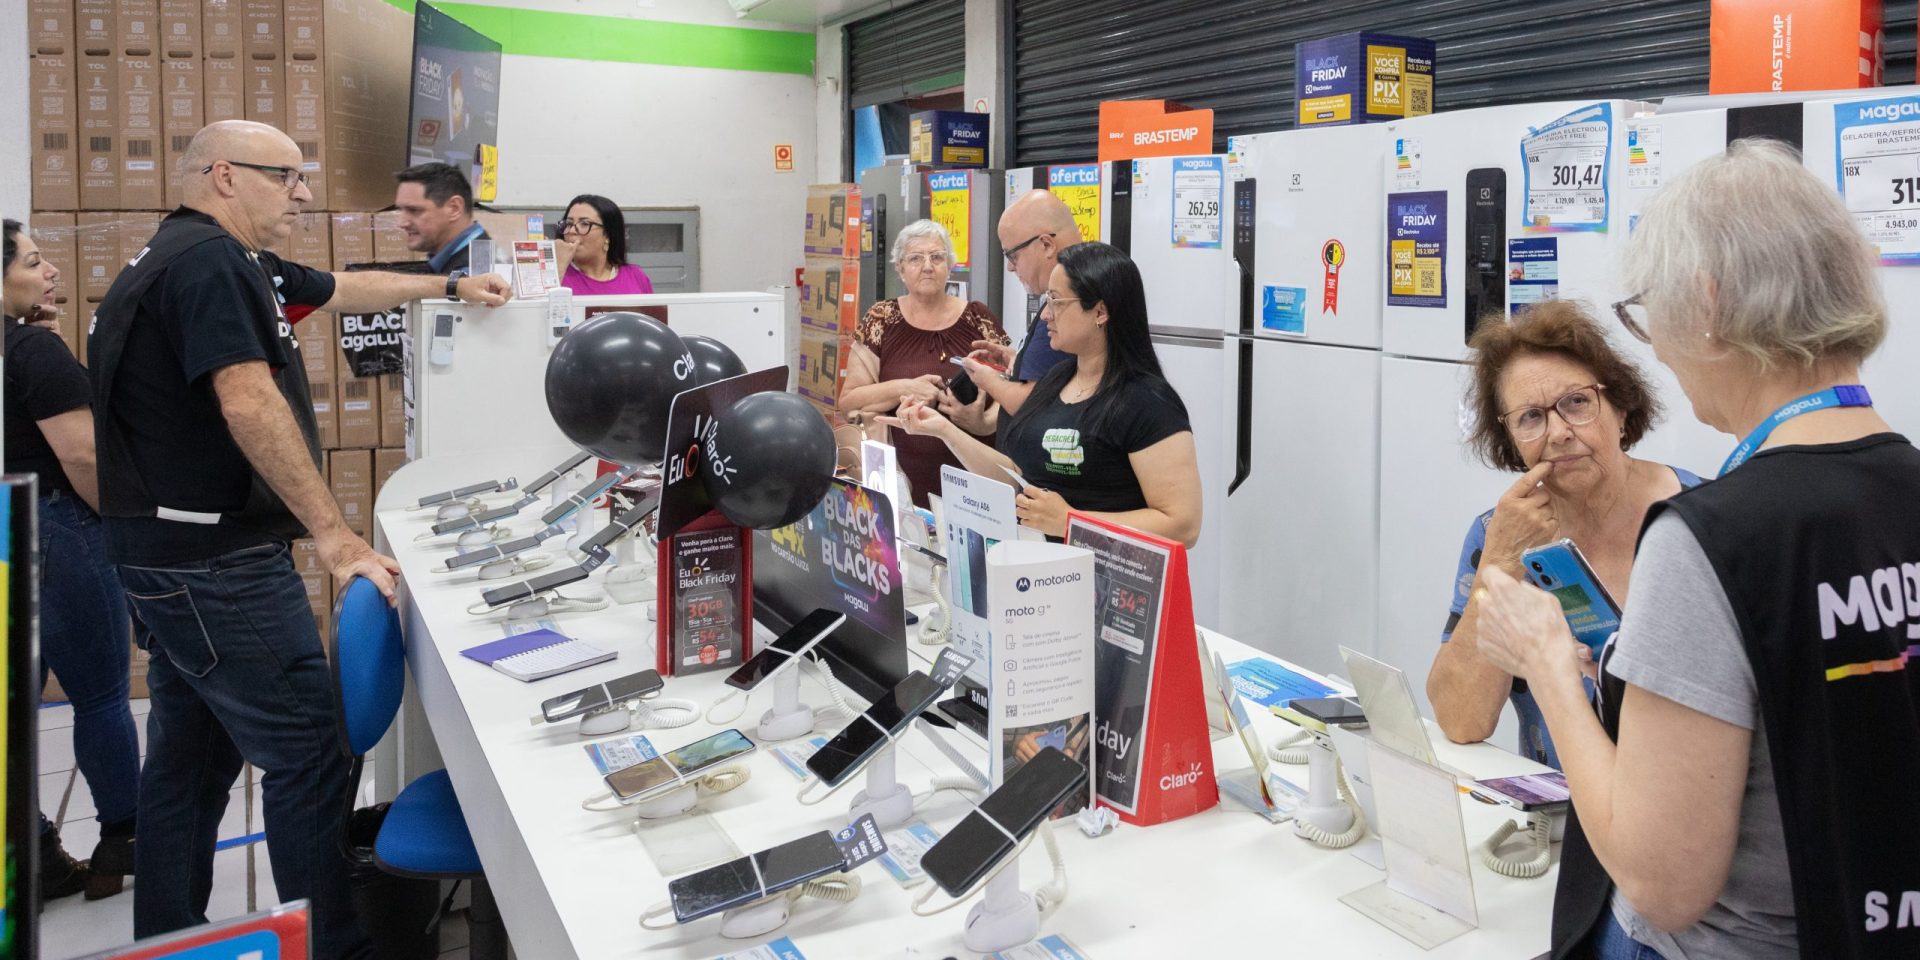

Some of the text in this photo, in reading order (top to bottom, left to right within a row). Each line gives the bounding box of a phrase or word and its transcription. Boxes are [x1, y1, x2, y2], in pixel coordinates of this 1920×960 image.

[1772, 14, 1784, 92] RASTEMP
[40, 59, 66, 67] TCL
[126, 60, 151, 69] TCL
[168, 62, 194, 70] TCL
[293, 64, 317, 73] TCL
[420, 57, 442, 80] BLACK
[1306, 56, 1338, 71] BLACK
[1374, 56, 1400, 68] VOCÊ
[1312, 66, 1347, 82] FRIDAY
[419, 76, 441, 96] FRIDAY
[1374, 81, 1399, 97] PIX
[953, 130, 981, 140] FRIDAY
[1134, 128, 1198, 145] BRASTEMP
[1564, 126, 1607, 134] ELECTROLUX
[1050, 168, 1098, 184] oferta!
[1552, 164, 1602, 190] 301,47
[1845, 166, 1860, 176] 18X
[931, 174, 968, 188] oferta!
[1188, 201, 1218, 218] 262,59
[1398, 204, 1427, 216] BLACK
[1403, 215, 1436, 226] FRIDAY
[1886, 220, 1917, 229] 4.943,00
[1395, 270, 1412, 280] PIX
[1774, 396, 1822, 420] Magalu
[706, 421, 725, 477] Claro
[668, 454, 684, 486] Eu
[943, 472, 968, 488] SAMSUNG
[962, 496, 980, 510] Galaxy
[824, 493, 880, 542] BLACK
[681, 540, 700, 548] Venha
[843, 529, 861, 550] DAS
[684, 546, 701, 557] ganhe
[702, 544, 719, 553] muito
[680, 568, 690, 578] Eu
[822, 536, 890, 595] BLACKS
[680, 572, 736, 589] Black Friday
[1034, 572, 1081, 588] motorola
[844, 593, 868, 612] Magalu
[1112, 597, 1119, 607] R$
[1006, 606, 1035, 617] moto
[944, 651, 970, 667] SAMSUNG
[1106, 770, 1126, 784] Claro
[1160, 763, 1203, 791] Claro
[841, 830, 850, 840] 5G
[862, 820, 883, 852] SAMSUNG
